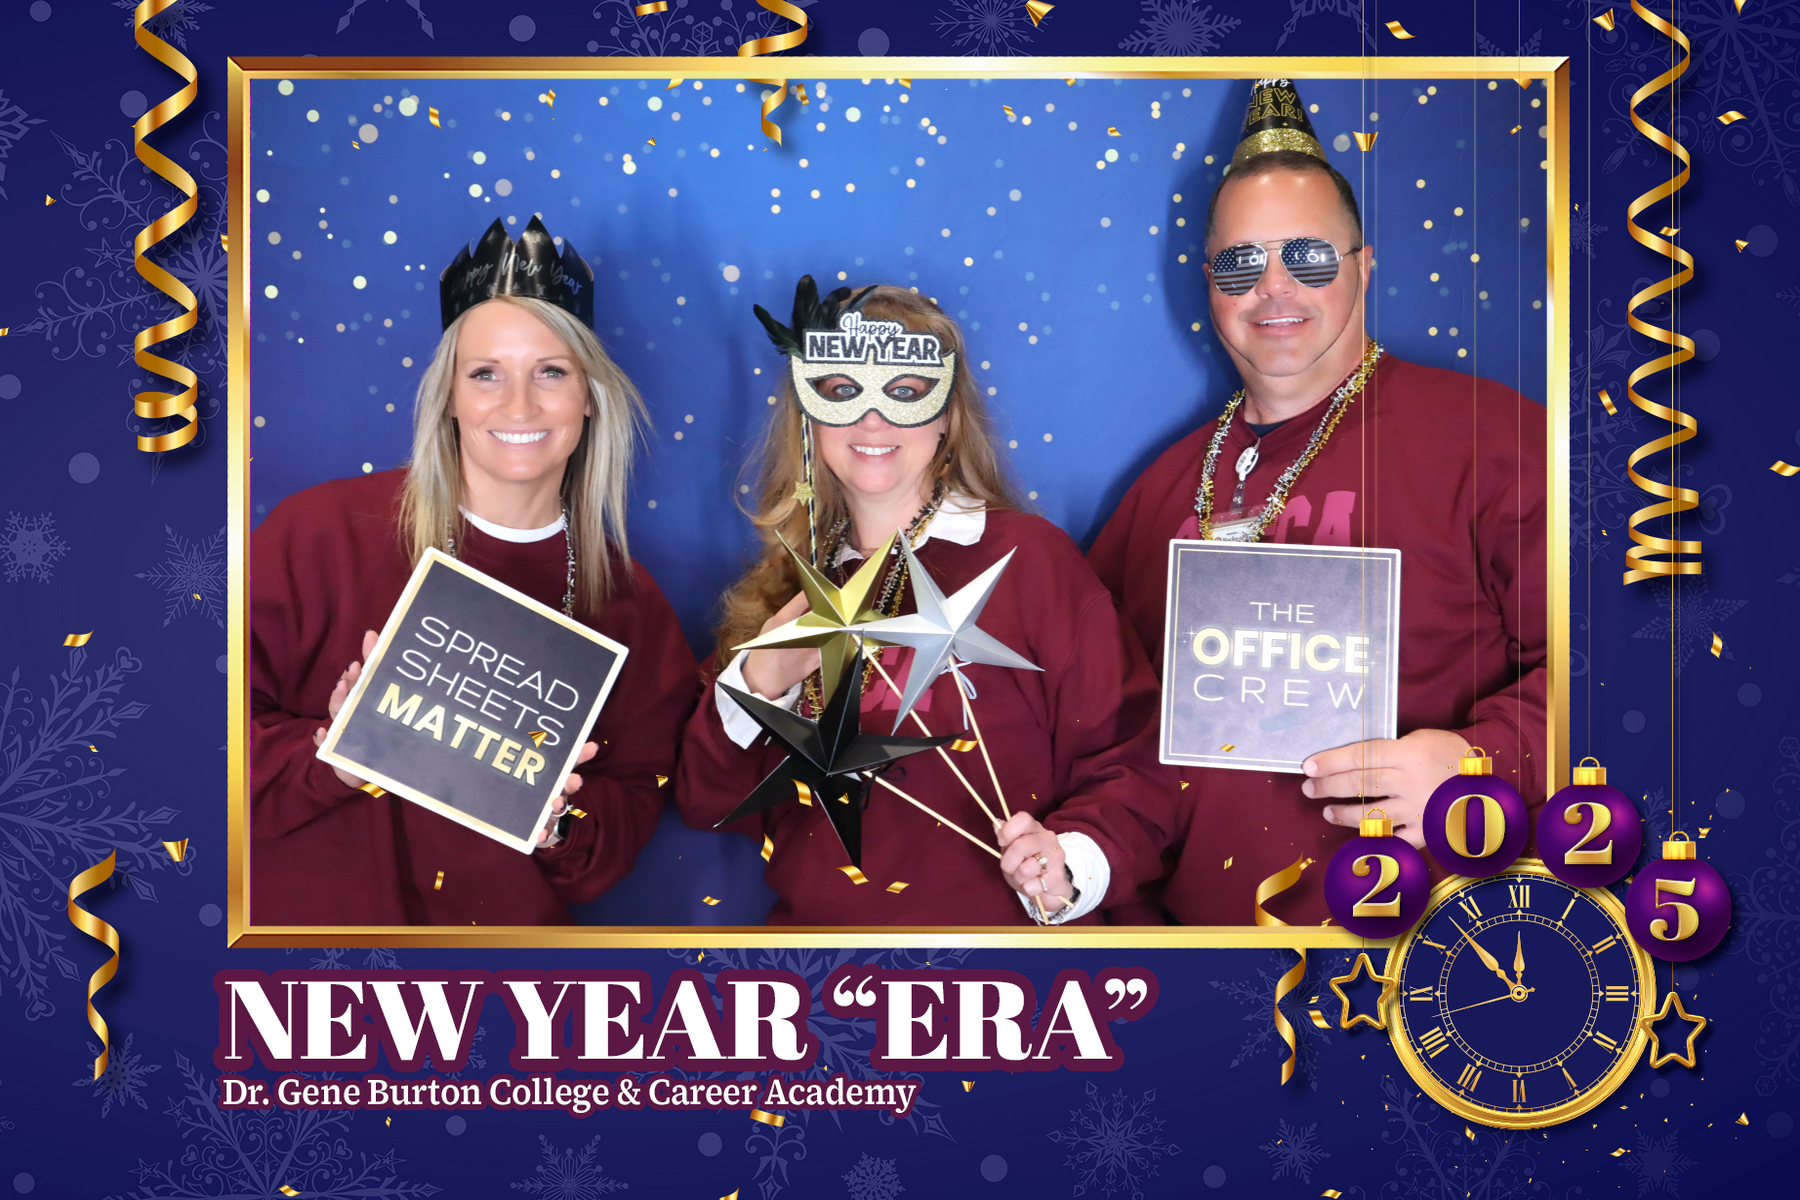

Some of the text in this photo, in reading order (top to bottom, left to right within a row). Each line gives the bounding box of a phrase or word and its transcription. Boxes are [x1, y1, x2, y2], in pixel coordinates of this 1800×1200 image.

[1247, 103, 1303, 126] EAR!
[502, 251, 542, 276] New
[550, 260, 583, 295] Year
[841, 314, 900, 341] Happy
[808, 334, 937, 362] NEW YEAR
[1250, 601, 1314, 624] THE
[415, 616, 579, 711] SPREAD
[1192, 627, 1370, 674] OFFICE
[396, 649, 565, 746] SHEETS
[1193, 673, 1366, 710] CREW
[376, 682, 546, 786] MATTER
